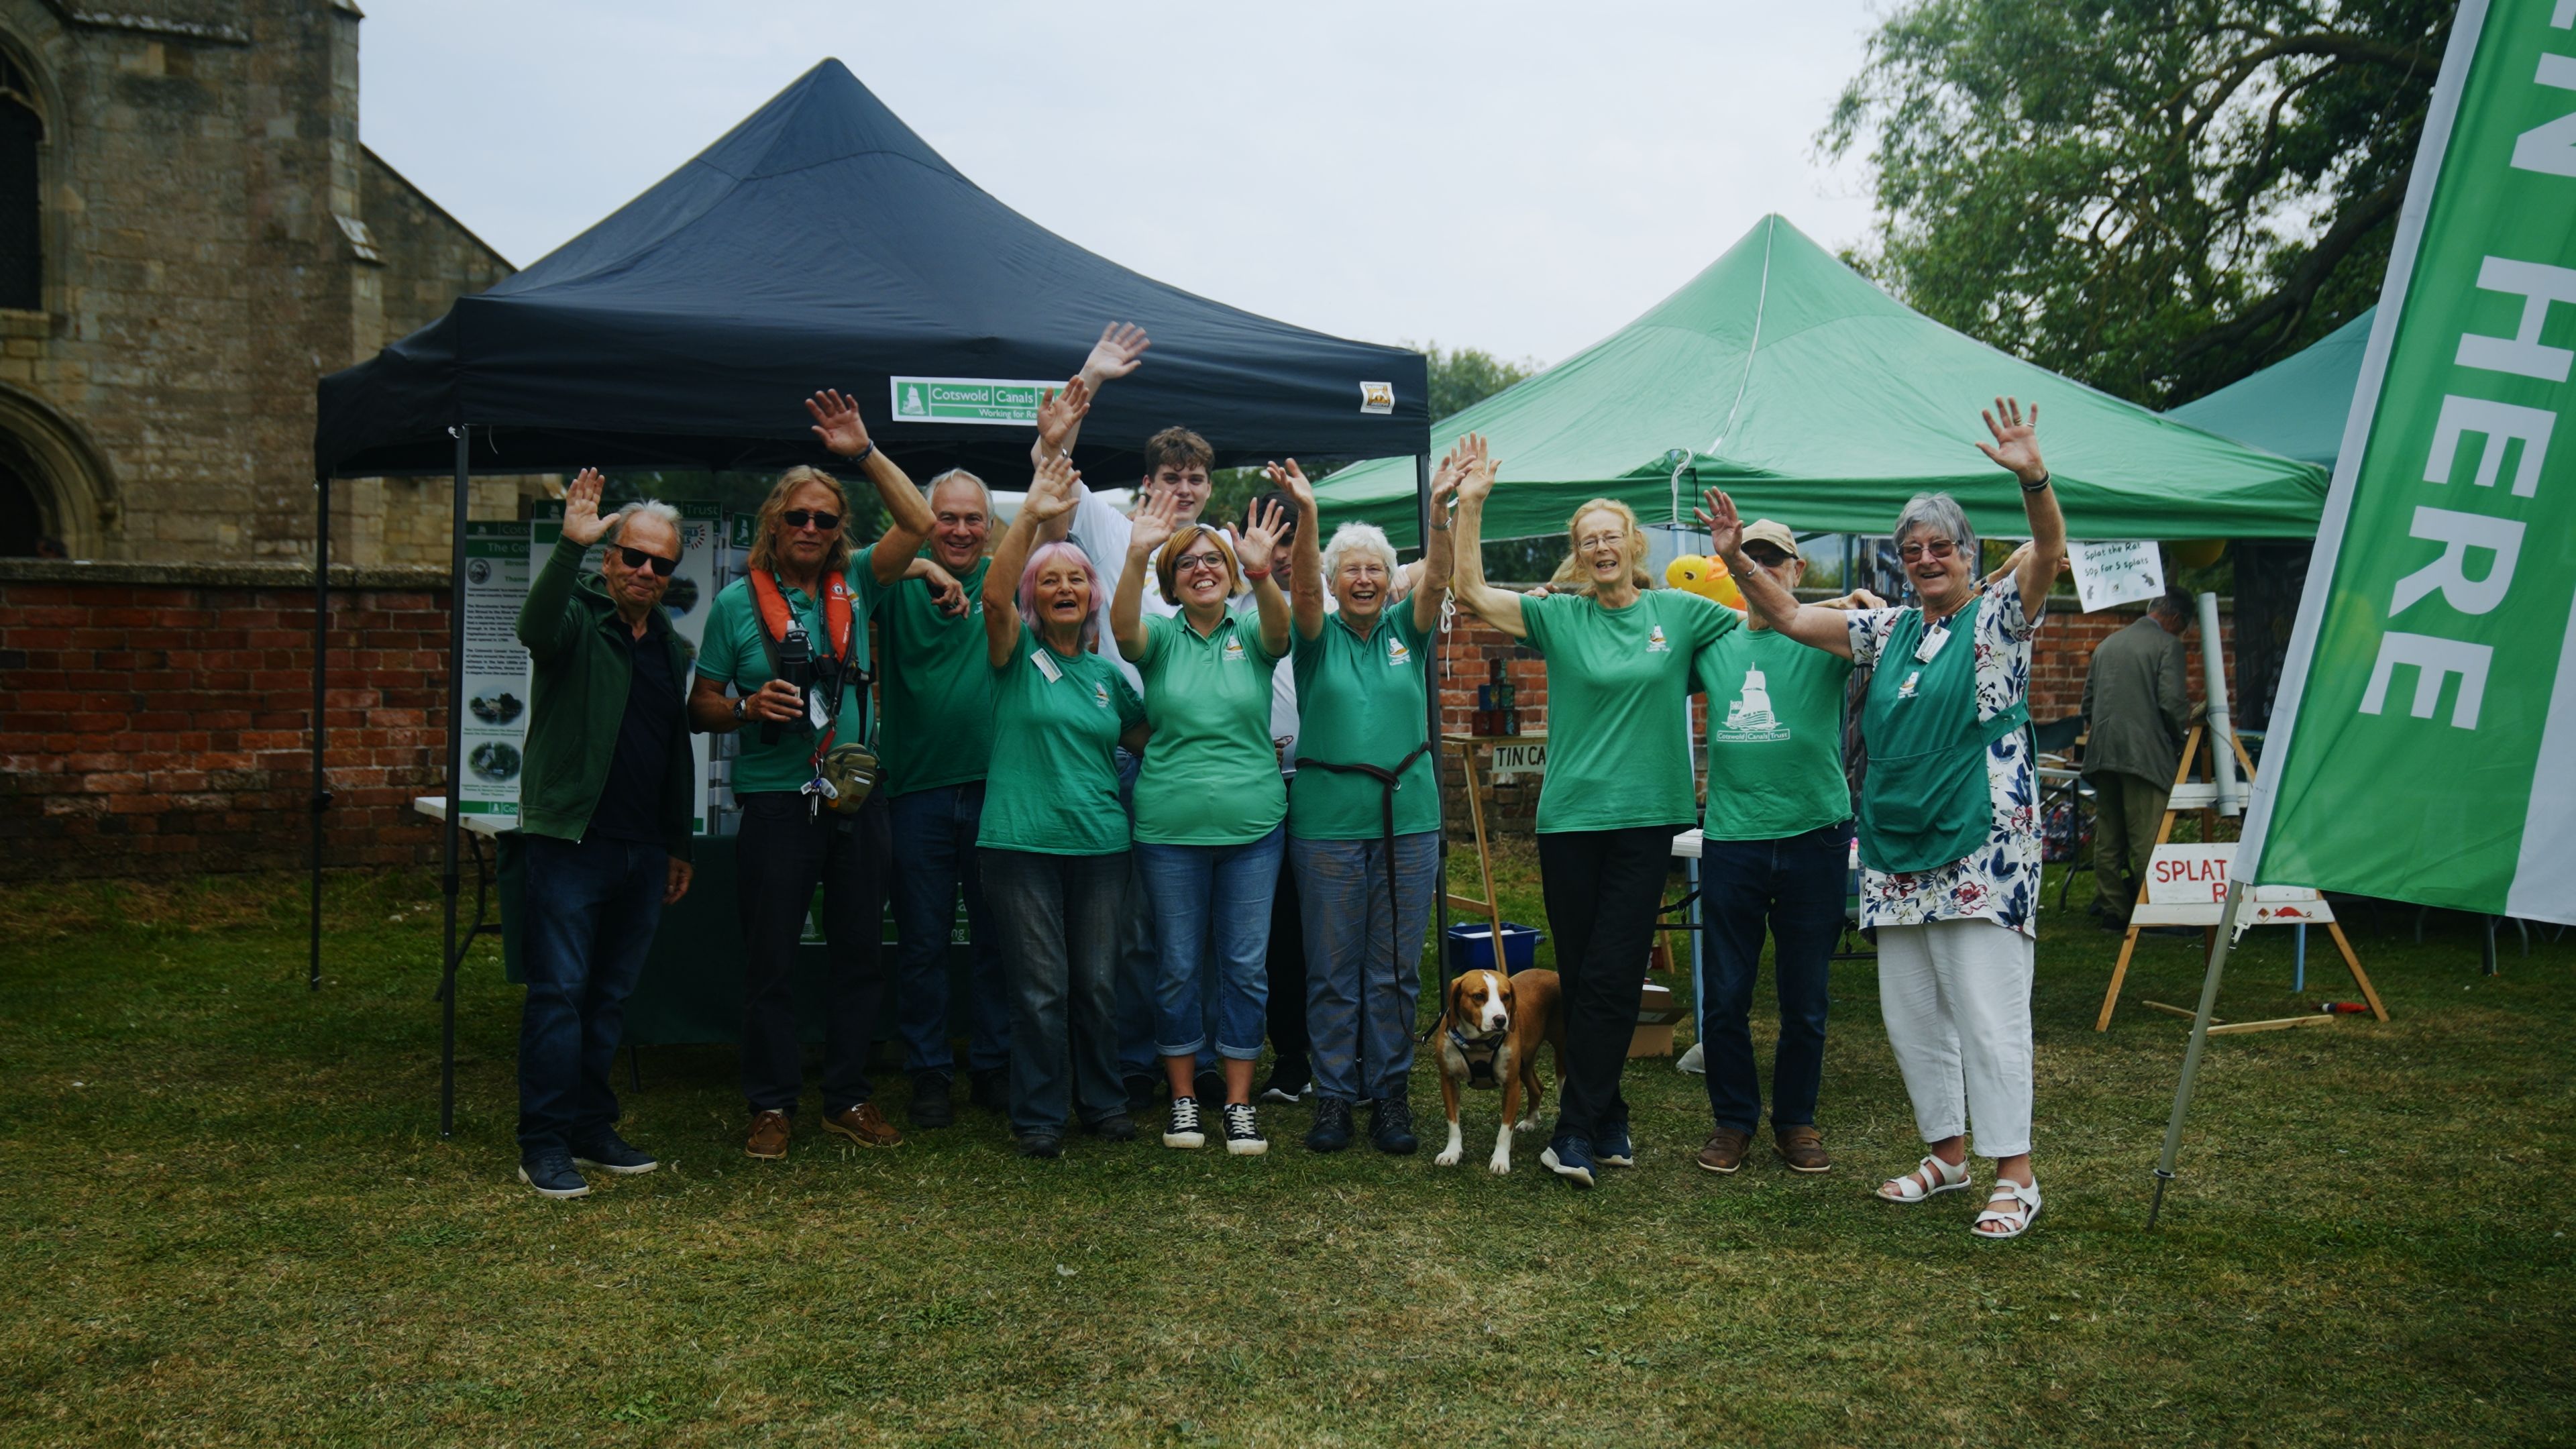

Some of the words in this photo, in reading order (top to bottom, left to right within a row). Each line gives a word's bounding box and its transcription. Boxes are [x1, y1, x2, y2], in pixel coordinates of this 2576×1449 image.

[932, 388, 988, 402] Cotswold
[996, 390, 1034, 403] Canals
[979, 409, 1011, 419] Working
[1013, 410, 1024, 419] for
[2358, 255, 2576, 731] HERE
[686, 504, 718, 515] Trust
[502, 525, 530, 535] Cots
[487, 543, 508, 553] The
[2084, 549, 2107, 561] Splat
[2108, 544, 2122, 555] the
[2125, 542, 2141, 552] Rat
[2085, 568, 2098, 577] 50p
[2116, 561, 2121, 570] 5
[2124, 557, 2149, 570] splats
[1496, 747, 1524, 767] TIN
[1527, 746, 1546, 766] CA
[2155, 859, 2227, 883] SPLAT
